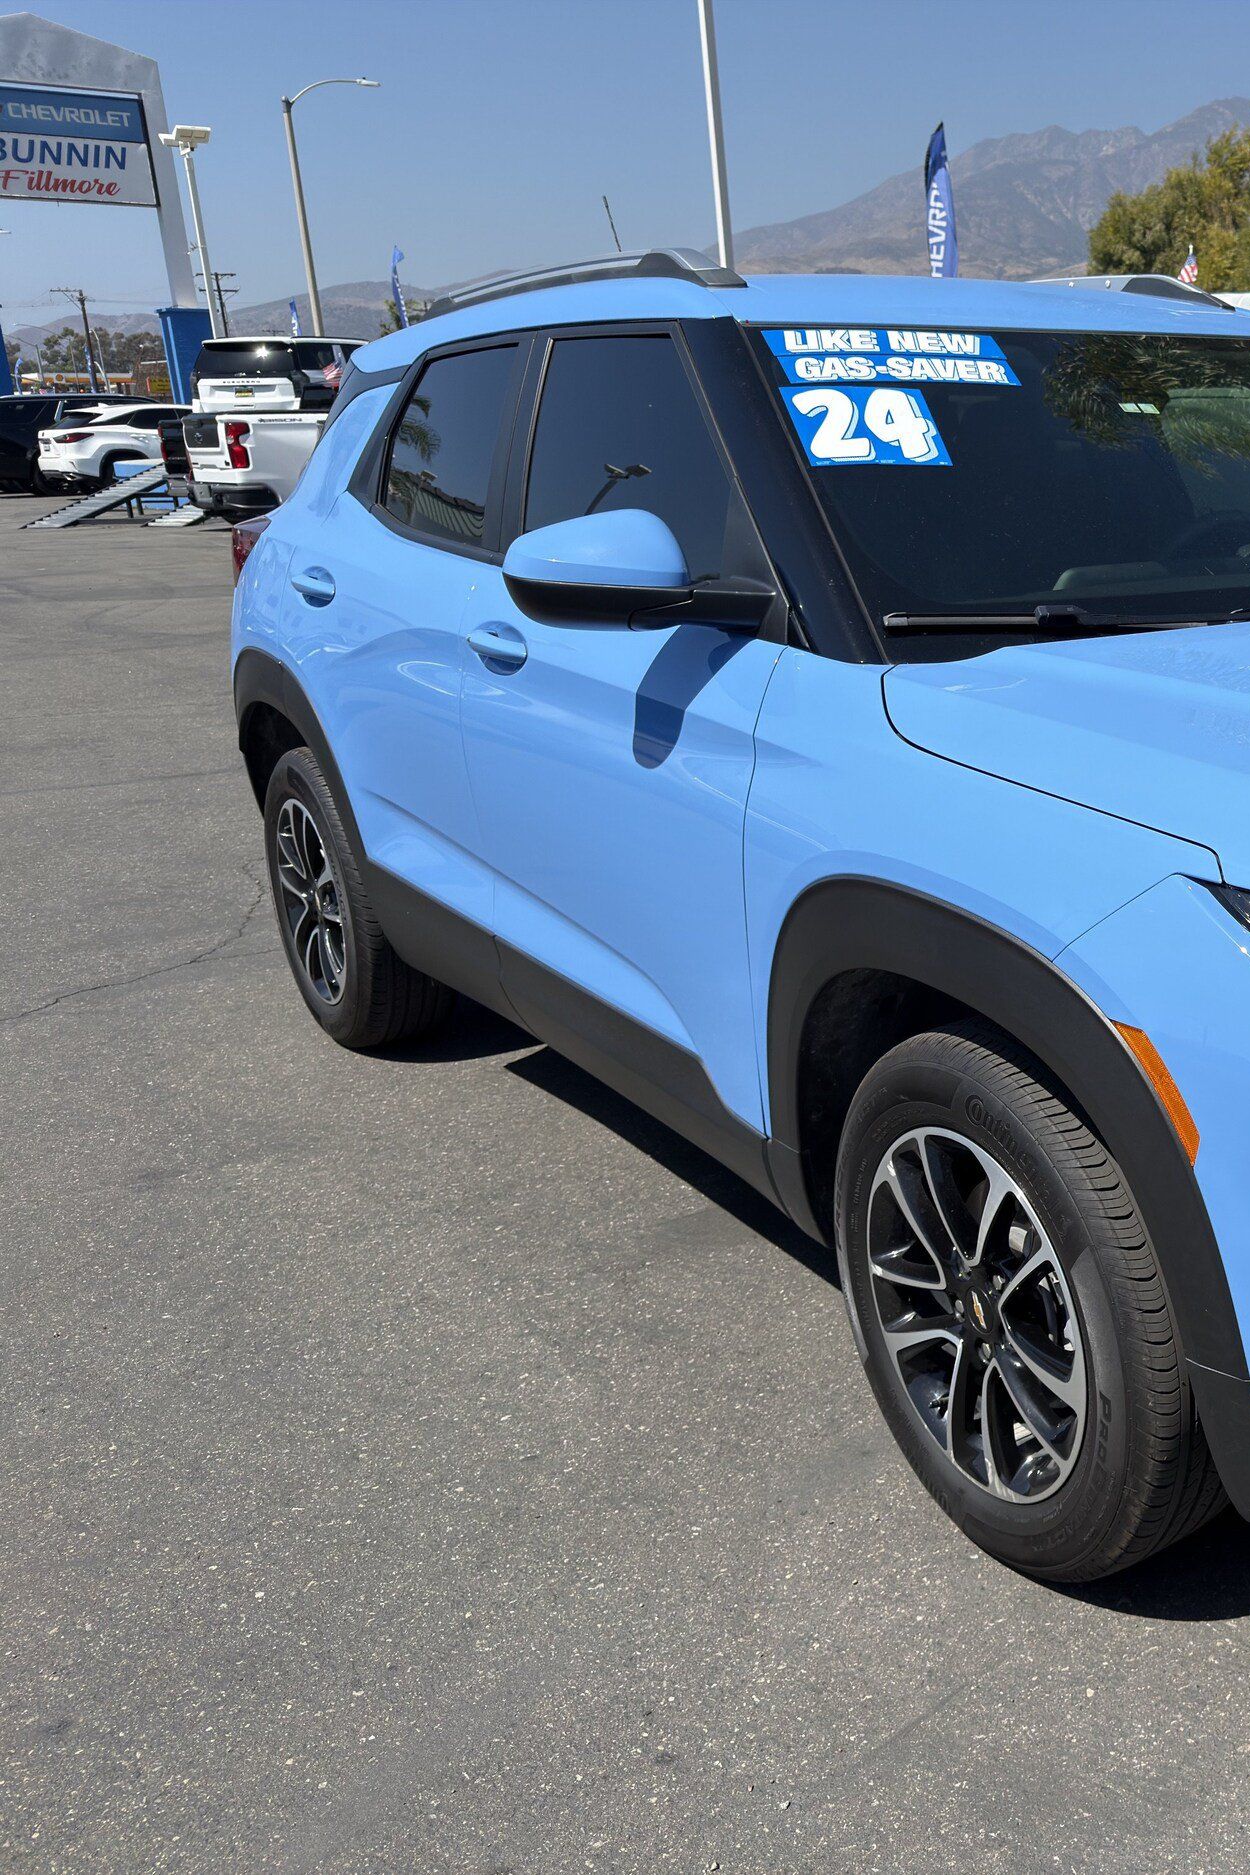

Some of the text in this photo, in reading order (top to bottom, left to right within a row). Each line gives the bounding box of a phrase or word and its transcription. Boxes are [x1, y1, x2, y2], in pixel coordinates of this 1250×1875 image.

[7, 102, 131, 127] CHEVROLET
[0, 169, 121, 197] Fillmore
[783, 330, 980, 355] LIKE NEW
[794, 356, 1010, 383] GAS-SAVER
[792, 388, 939, 463] 24
